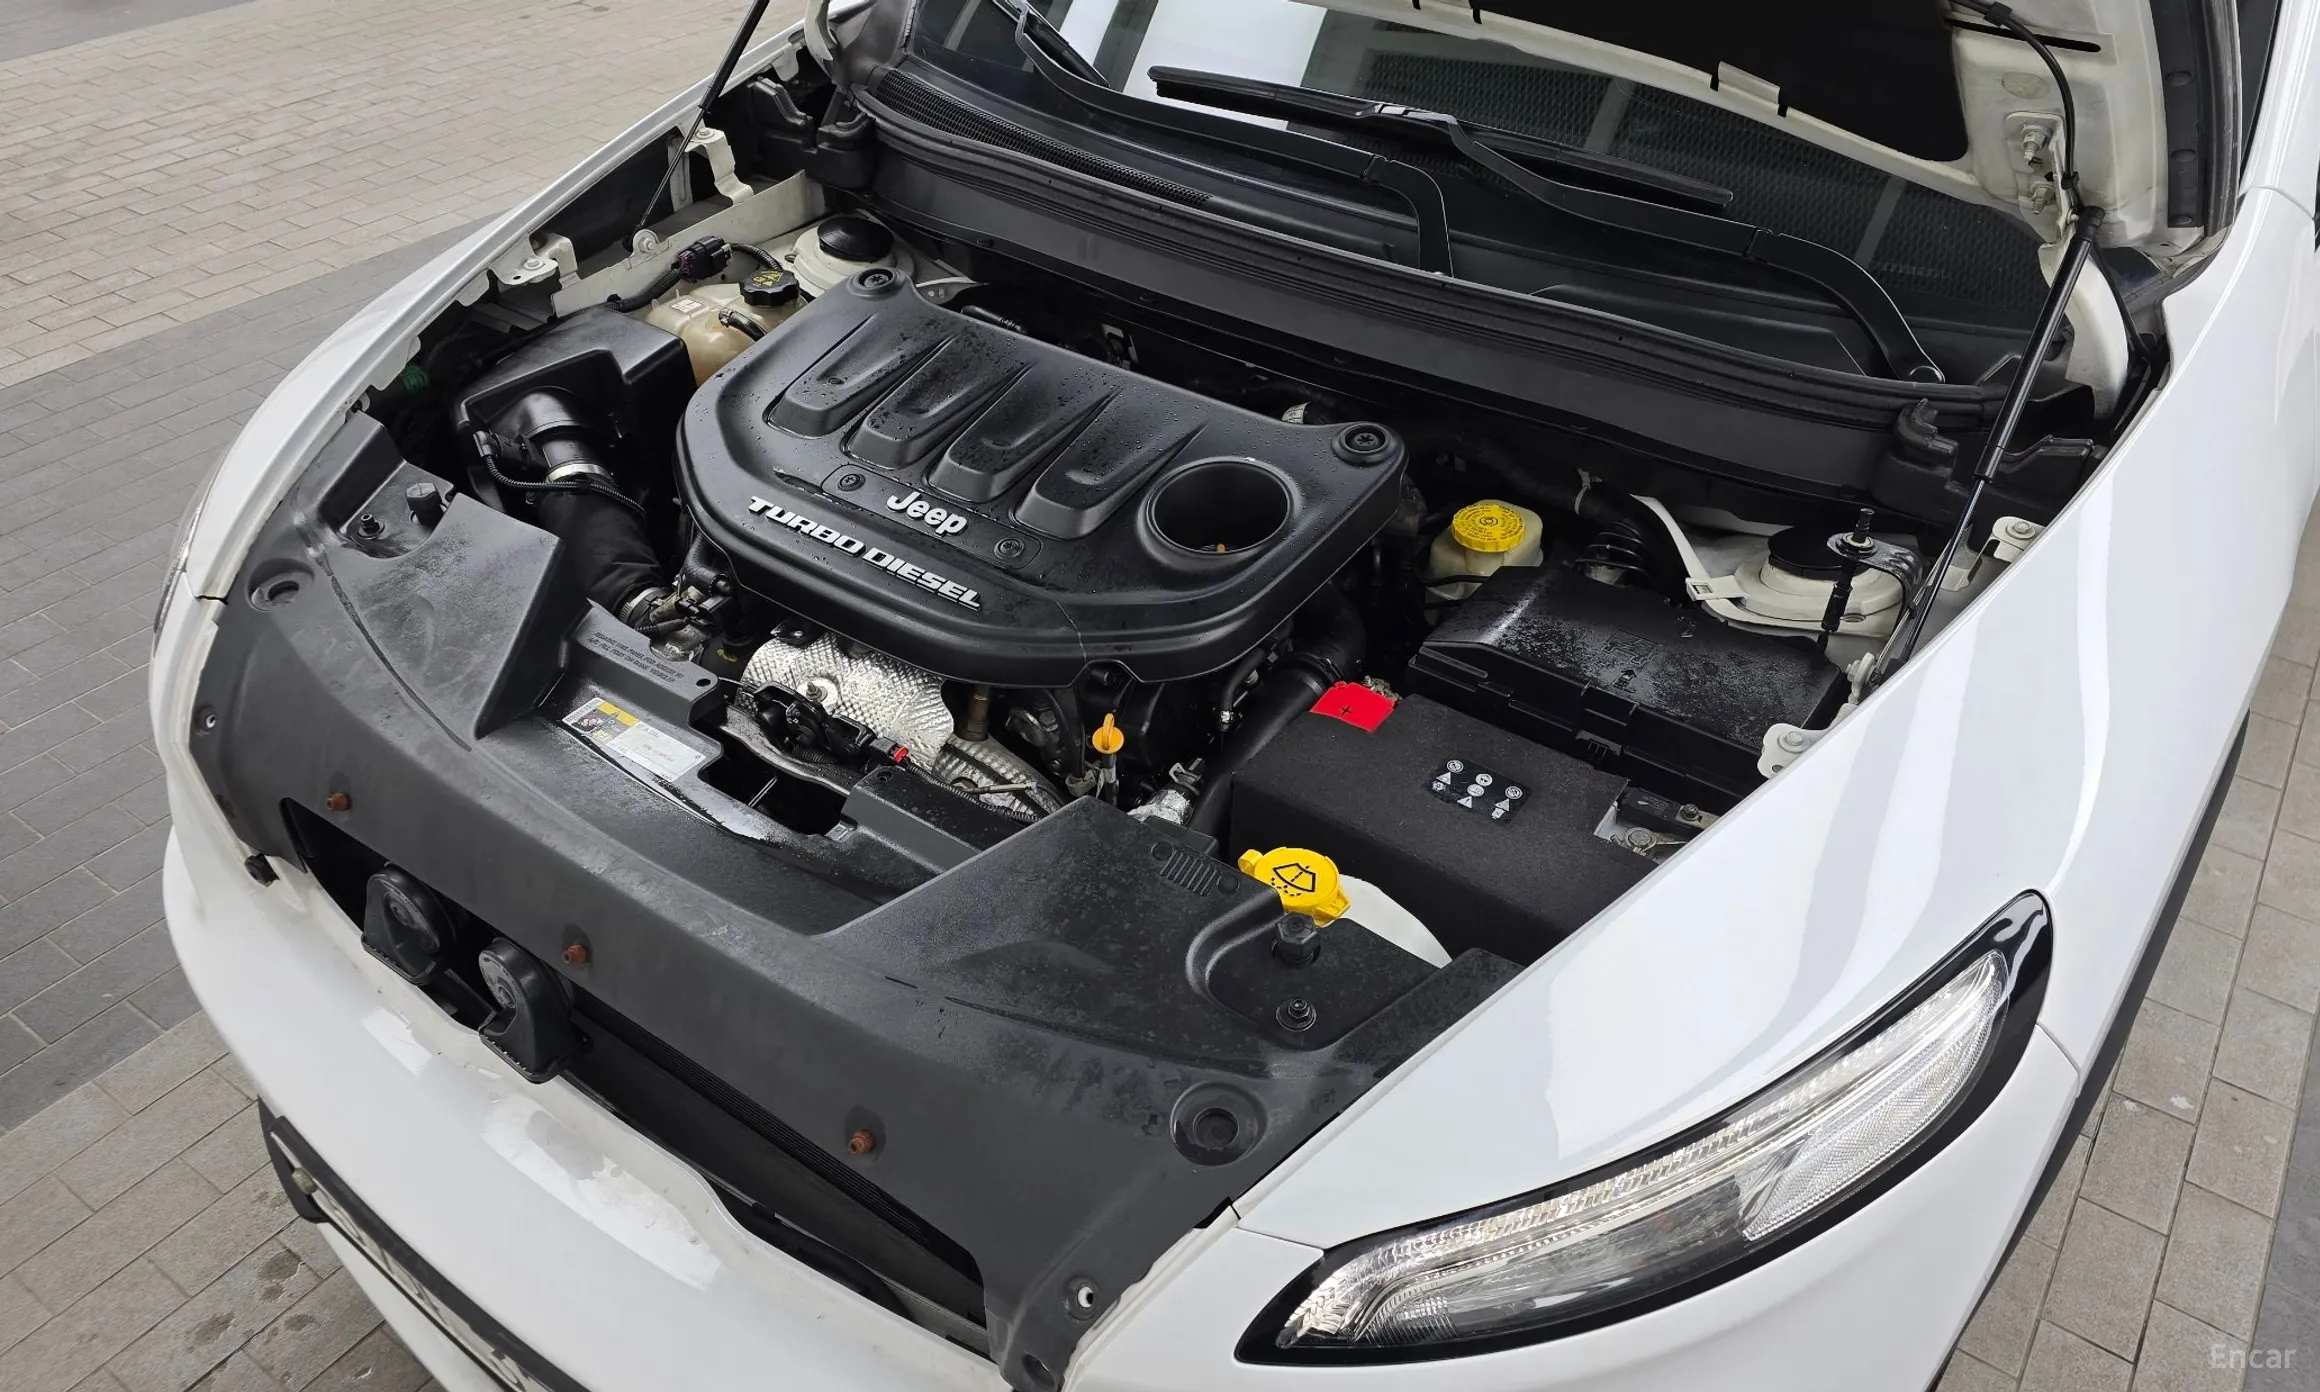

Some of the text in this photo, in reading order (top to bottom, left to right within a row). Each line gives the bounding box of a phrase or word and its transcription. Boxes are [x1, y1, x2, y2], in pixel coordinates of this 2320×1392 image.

[748, 496, 981, 610] TURBO DIESEL
[886, 491, 968, 536] Jeep
